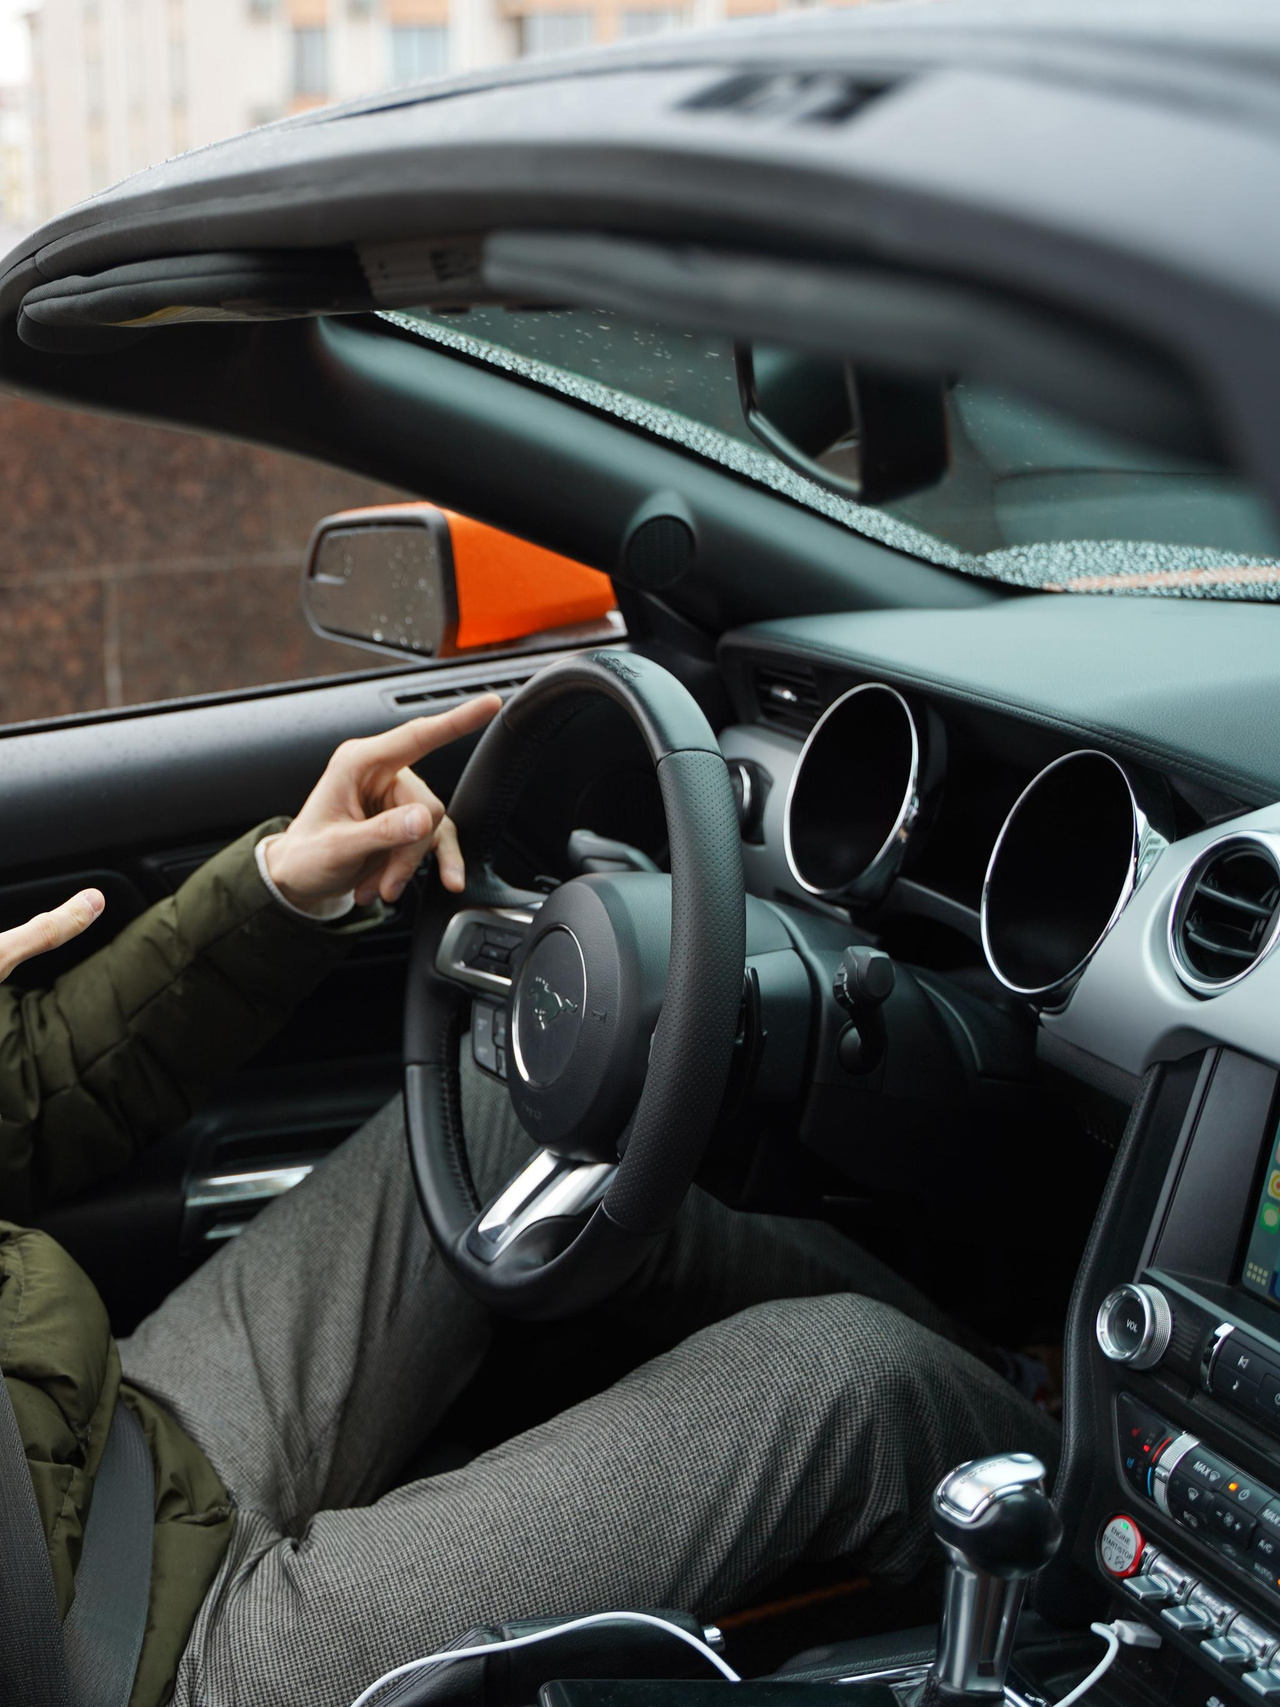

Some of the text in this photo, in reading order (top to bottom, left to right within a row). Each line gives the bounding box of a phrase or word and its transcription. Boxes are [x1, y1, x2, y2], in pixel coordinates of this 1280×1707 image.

[1126, 1318, 1138, 1333] VOL
[1193, 1461, 1211, 1477] MAX
[1111, 1526, 1131, 1545] ENGINE
[1102, 1534, 1133, 1560] START/STOP
[1258, 1540, 1274, 1554] A/C
